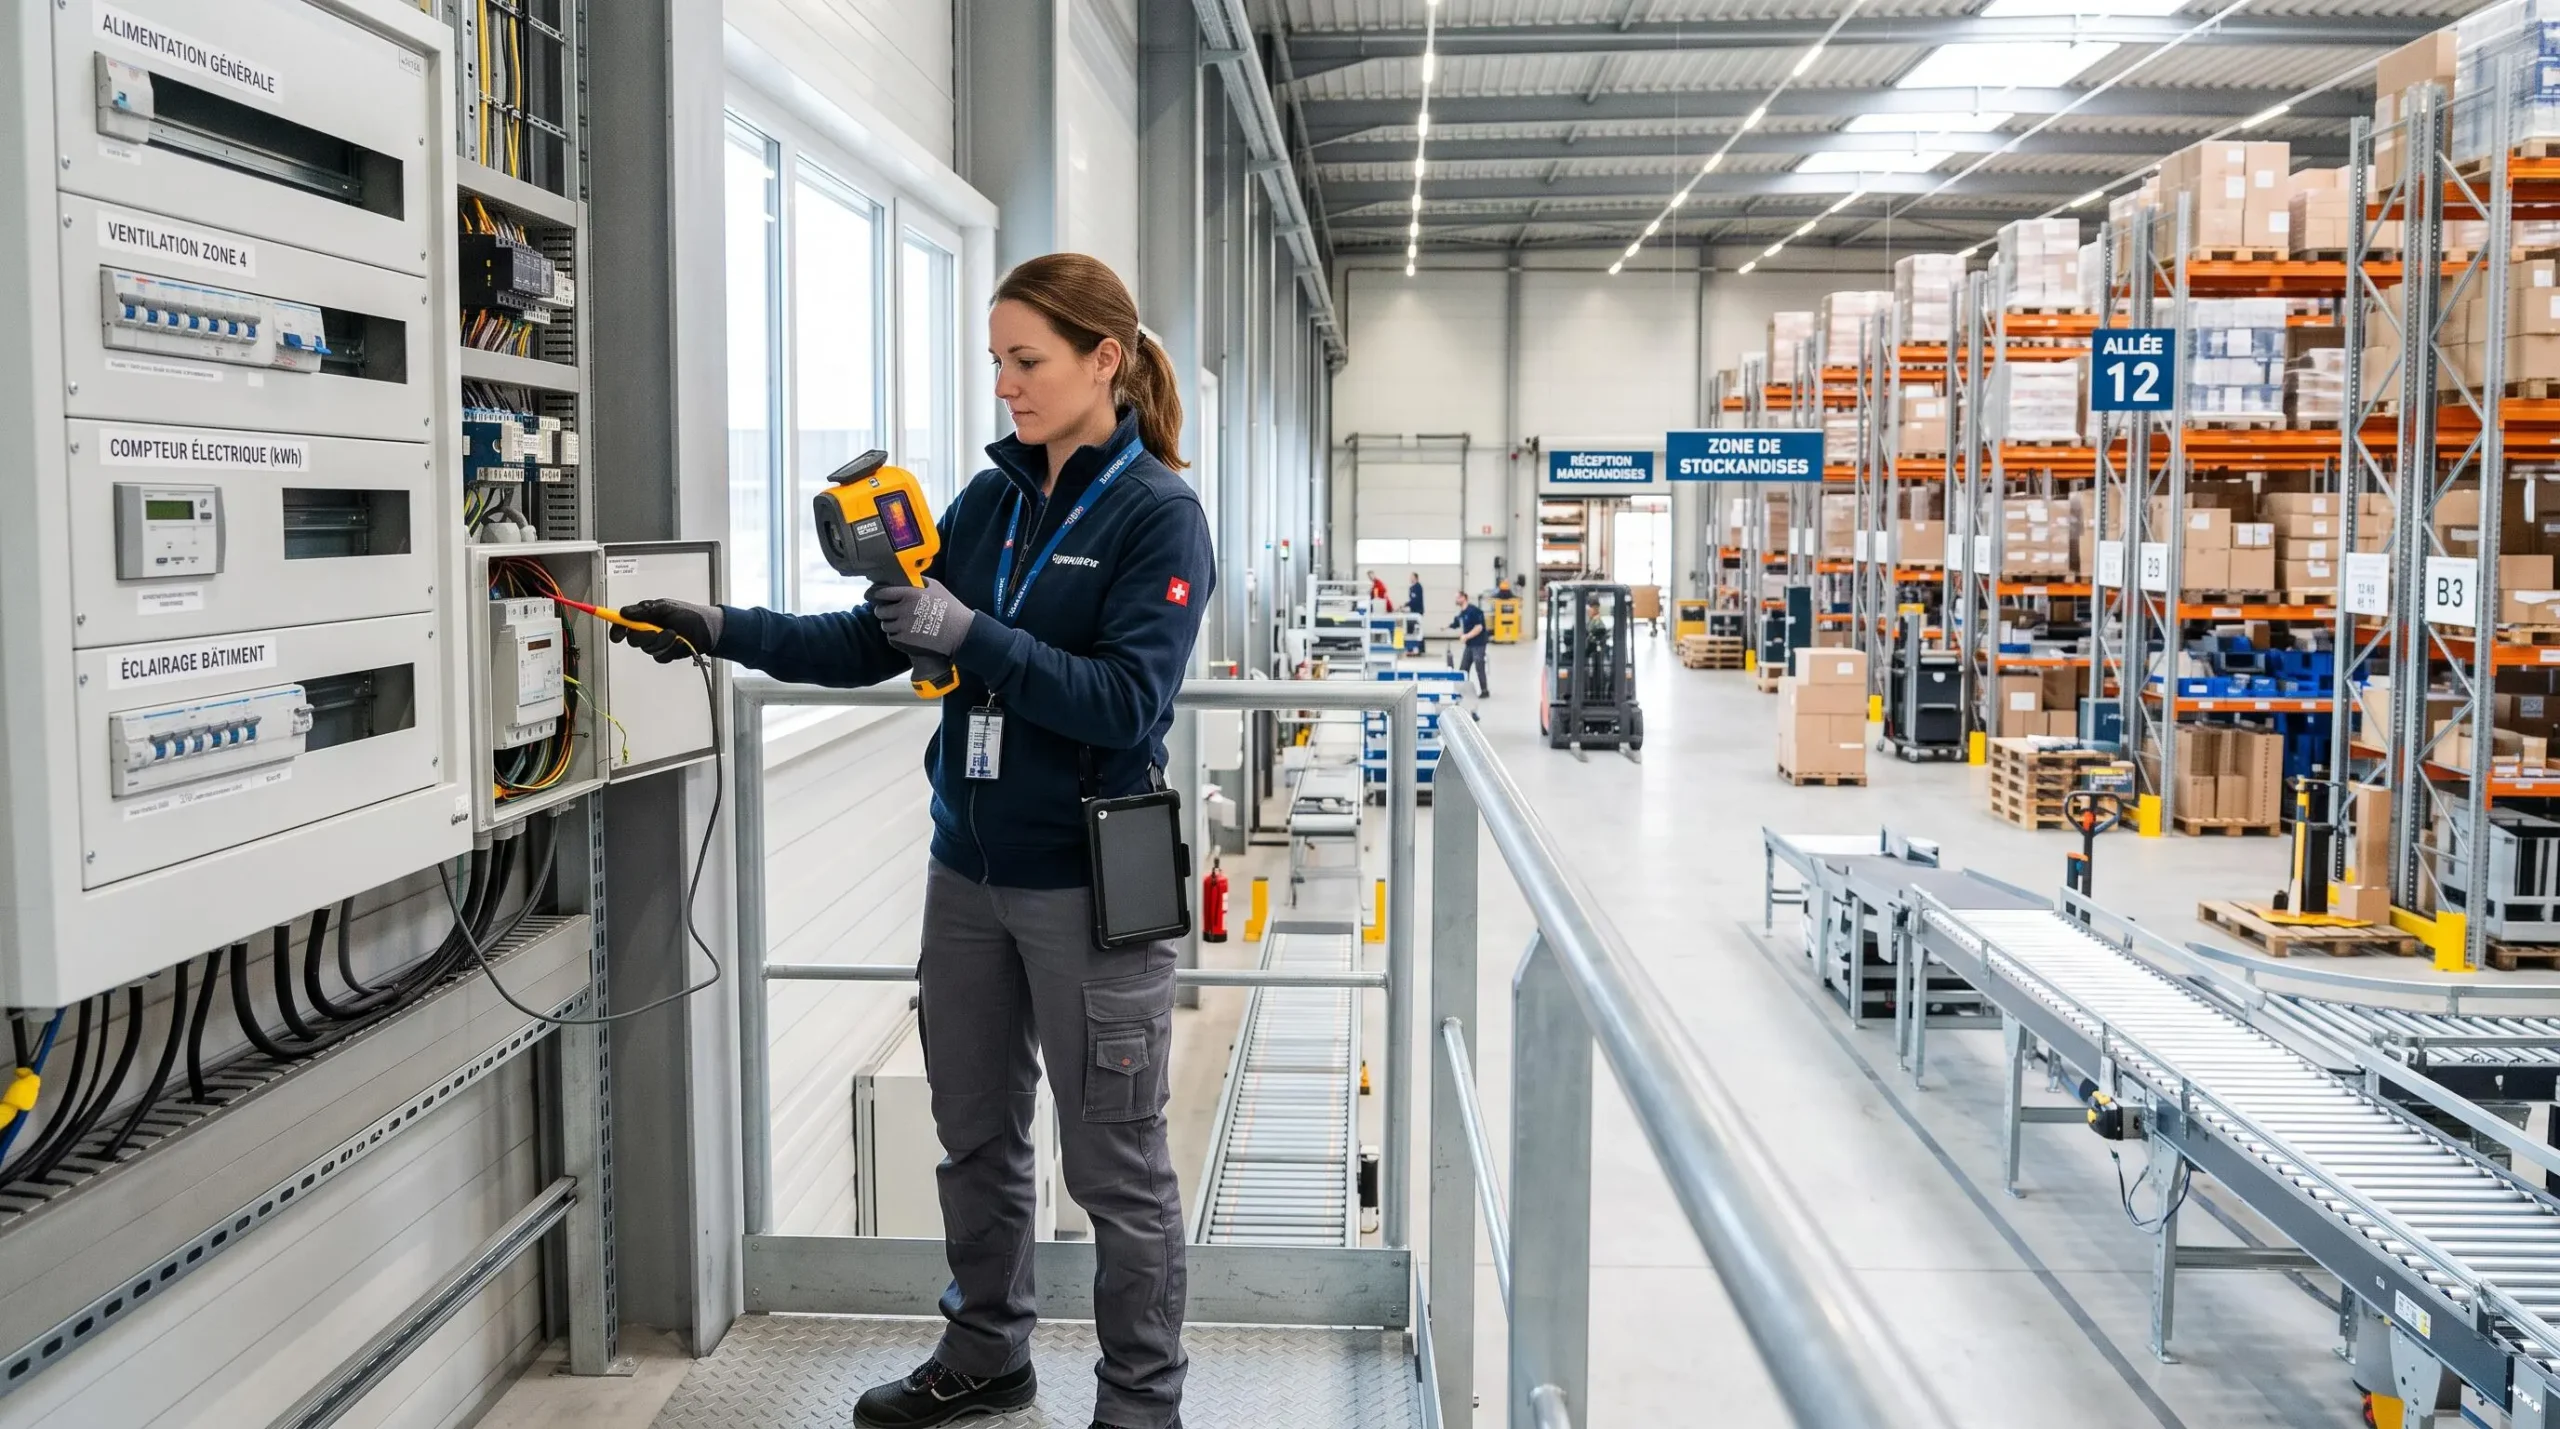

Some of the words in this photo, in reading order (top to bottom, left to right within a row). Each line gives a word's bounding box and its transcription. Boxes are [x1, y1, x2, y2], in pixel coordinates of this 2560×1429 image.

[102, 14, 207, 68] ALIMENTATION
[210, 53, 275, 94] GÉNÉRALE
[108, 221, 199, 257] VENTILATION
[202, 242, 237, 266] ZONE
[239, 251, 247, 267] 4
[2102, 332, 2163, 355] ALLÉE
[2106, 361, 2160, 402] 12
[110, 438, 188, 460] COMPTEUR
[192, 438, 267, 465] ÉLECTRIQUE
[270, 446, 302, 468] (kWh)
[1570, 452, 1632, 467] RÉCEPTION
[1708, 438, 1755, 454] ZONE
[1758, 438, 1782, 454] DE
[1556, 468, 1646, 480] MARCHANDISES
[1679, 458, 1809, 475] STOCKANDISES
[2437, 577, 2464, 607] B3
[121, 653, 198, 680] ÉCLAIRAGE
